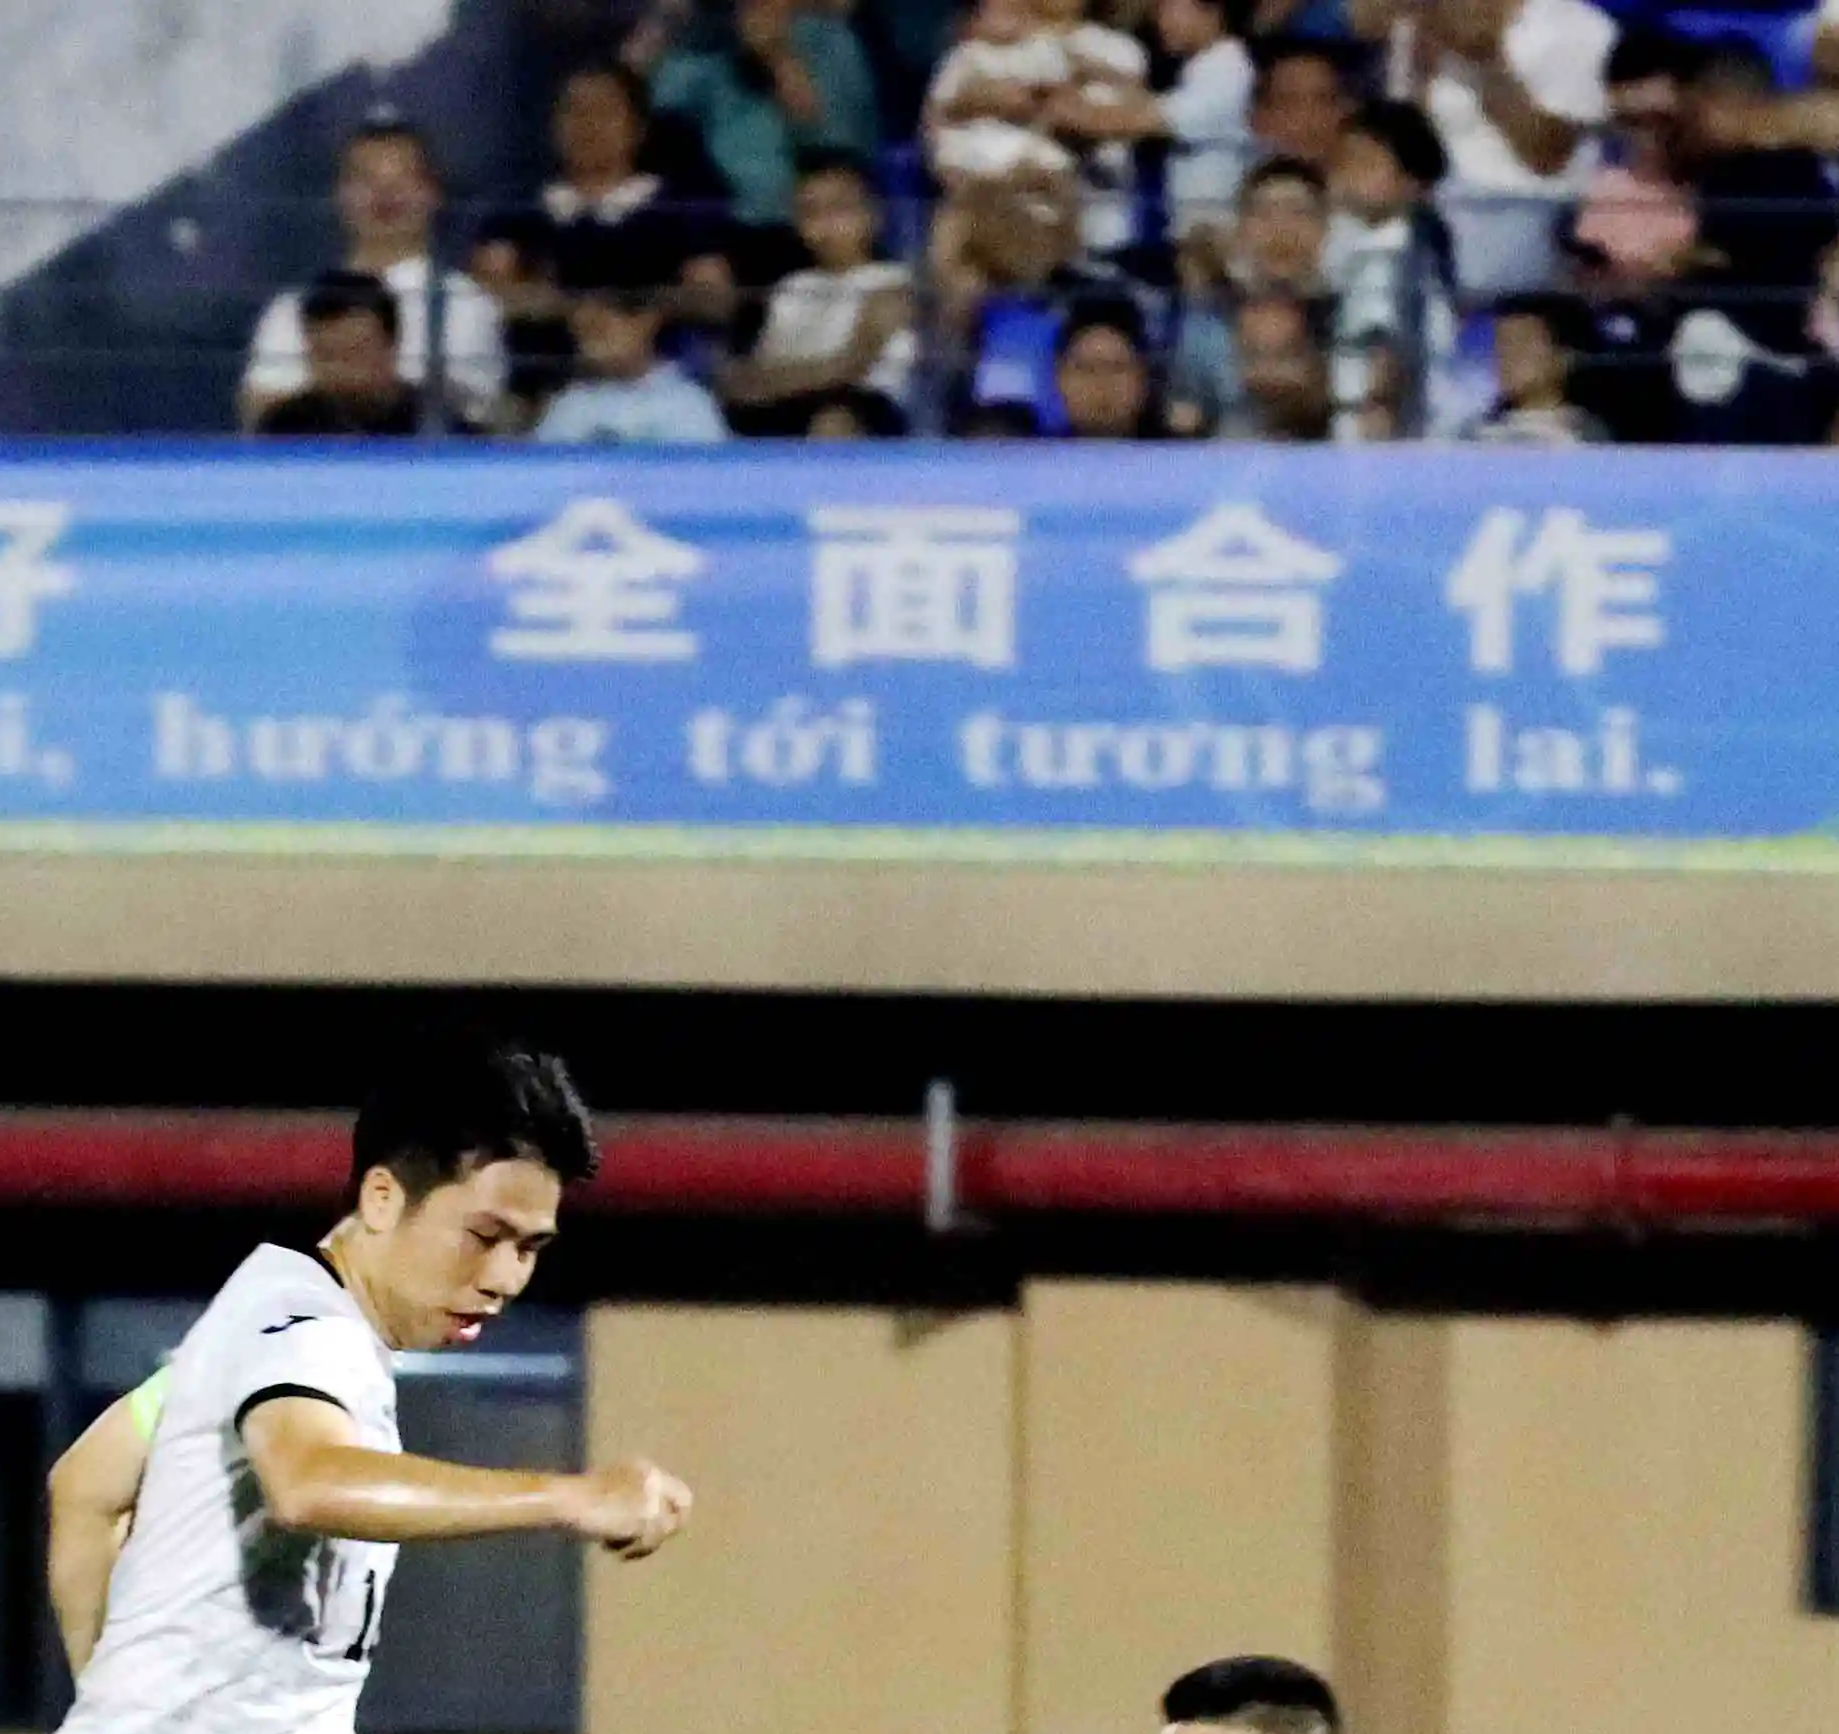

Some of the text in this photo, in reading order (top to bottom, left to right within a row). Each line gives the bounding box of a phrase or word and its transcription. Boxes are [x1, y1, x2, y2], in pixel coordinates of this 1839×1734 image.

[483, 495, 1674, 676] 全面合作
[1463, 702, 1683, 797] lai.
